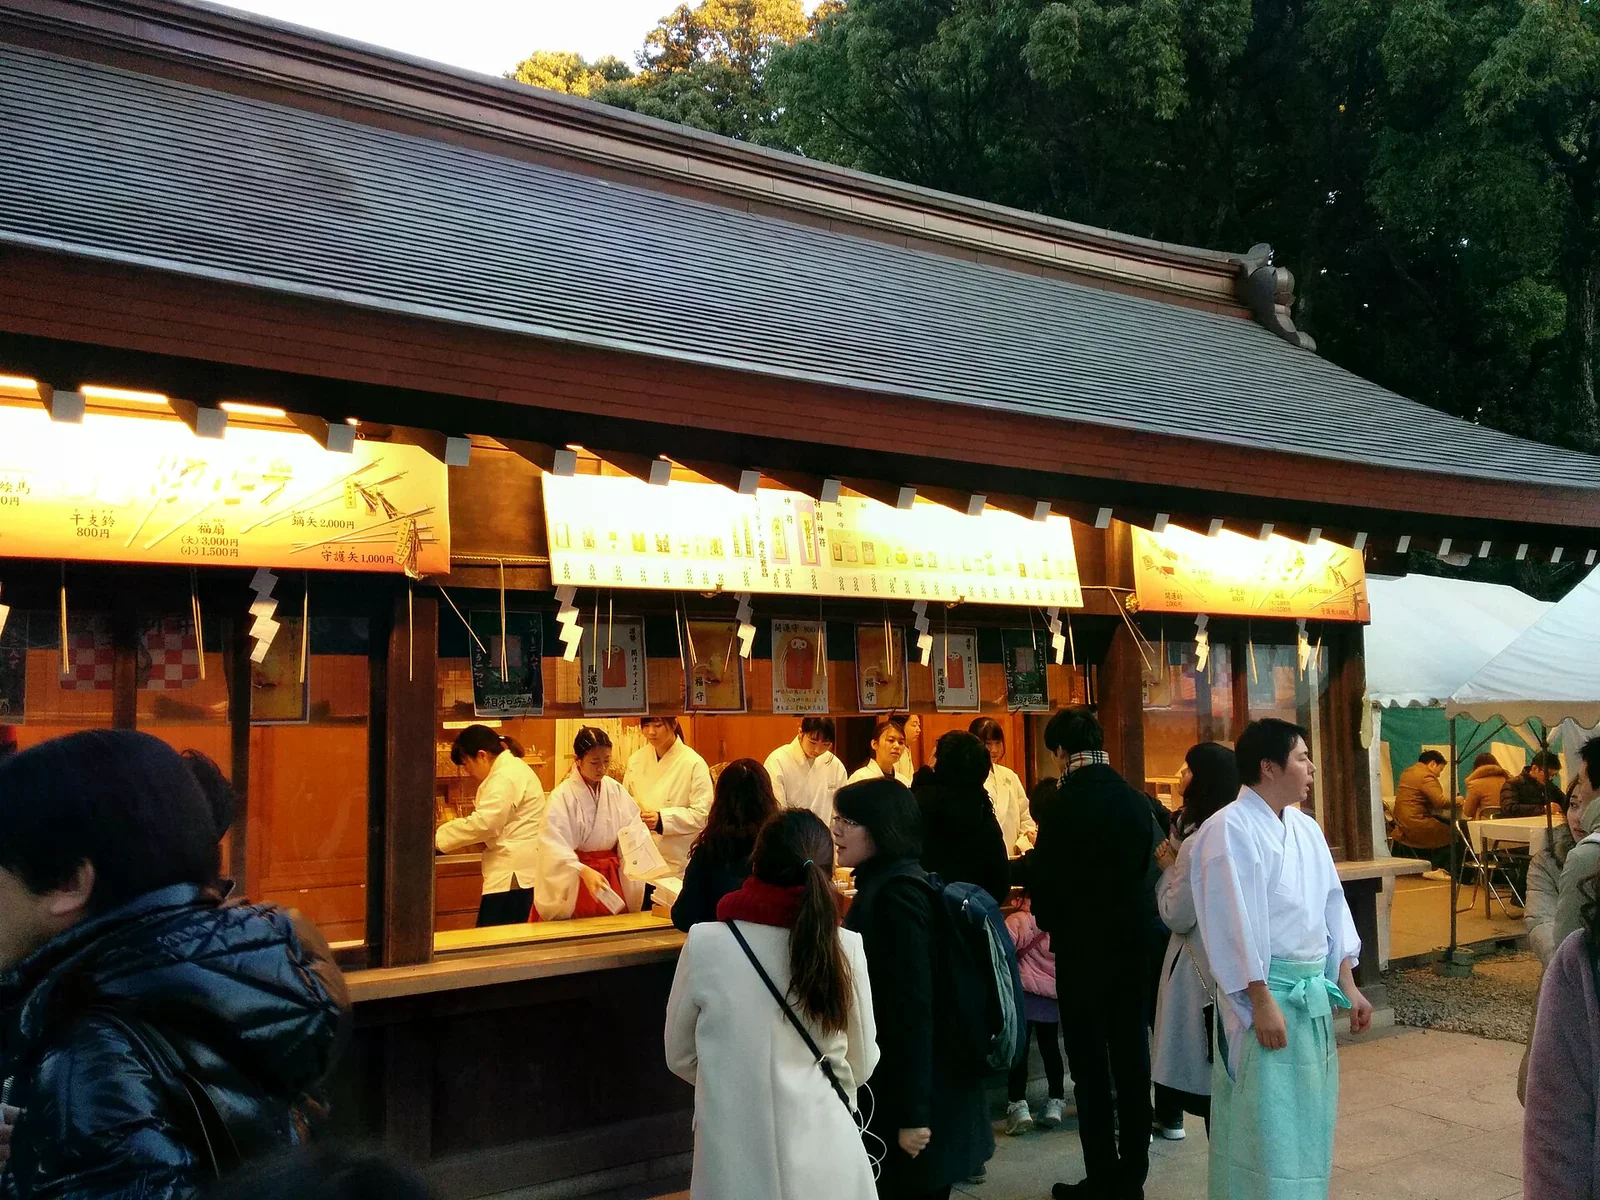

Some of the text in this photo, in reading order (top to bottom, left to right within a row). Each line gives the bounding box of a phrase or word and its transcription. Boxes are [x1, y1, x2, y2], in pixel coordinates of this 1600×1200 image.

[76, 527, 110, 539] 800円
[321, 549, 359, 564] 守護矢
[694, 676, 704, 702] 福守
